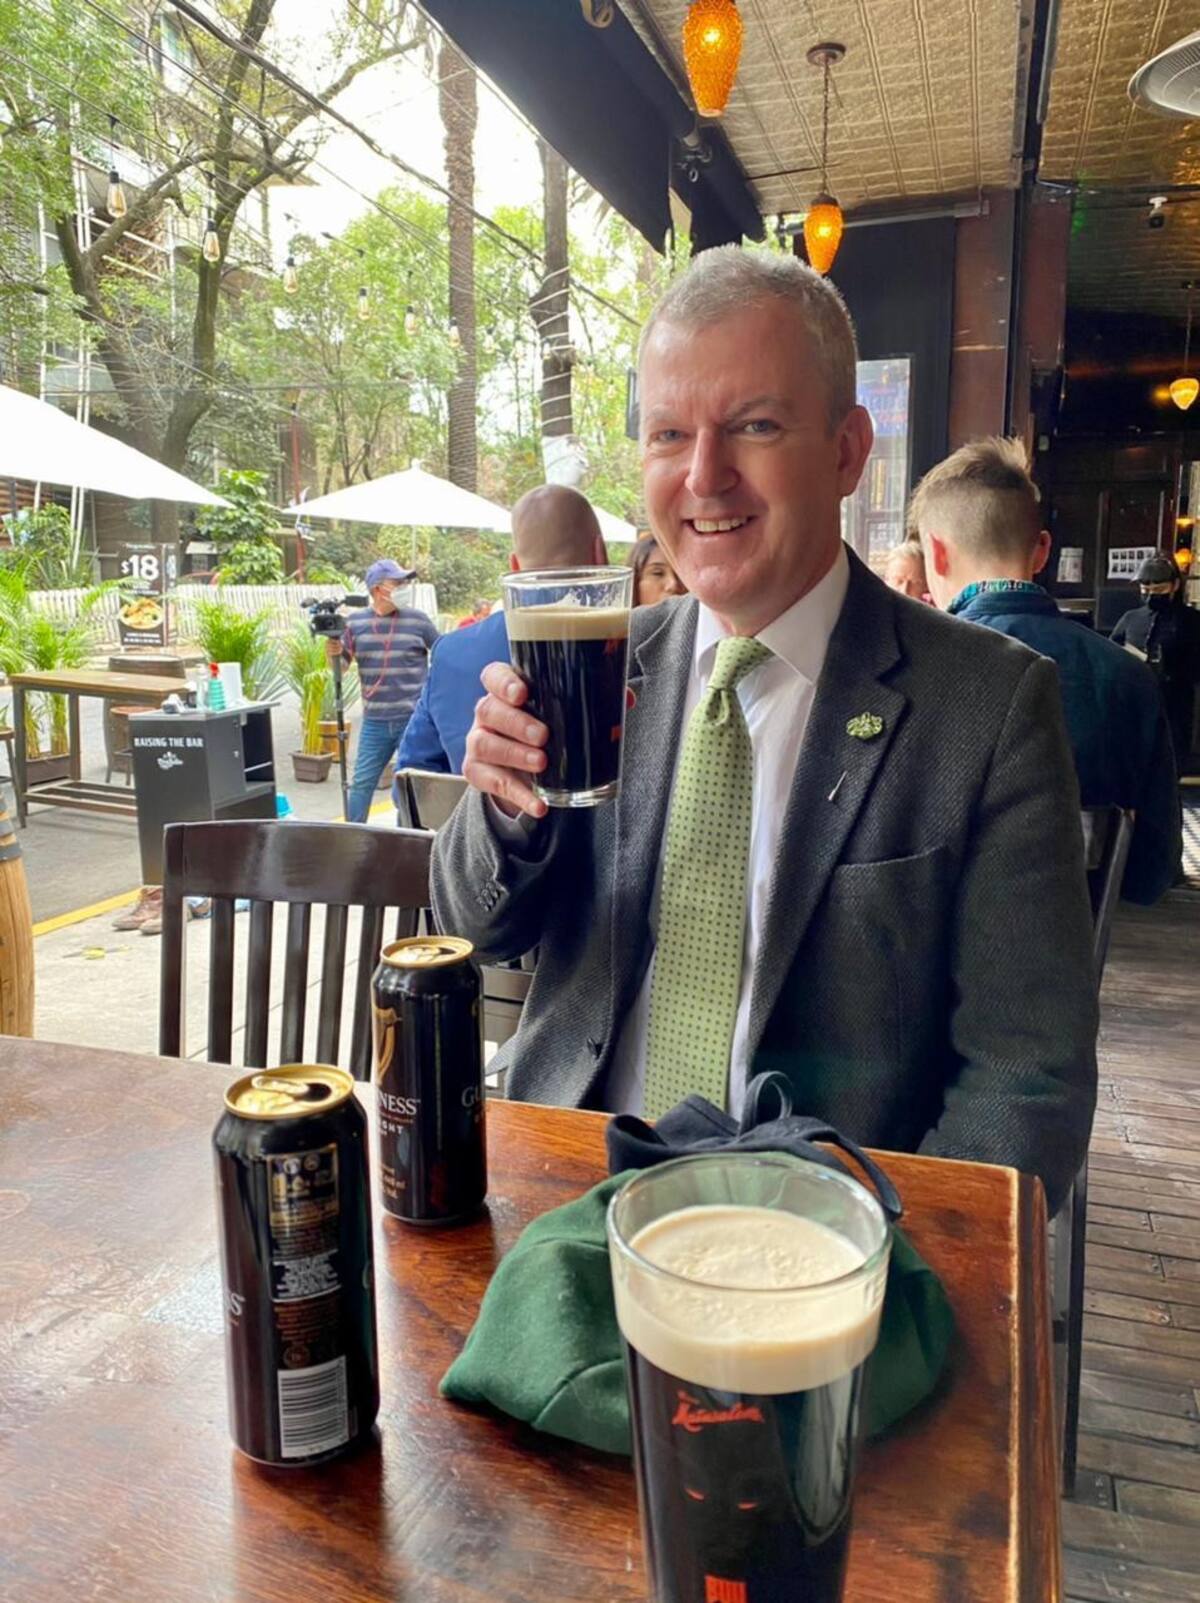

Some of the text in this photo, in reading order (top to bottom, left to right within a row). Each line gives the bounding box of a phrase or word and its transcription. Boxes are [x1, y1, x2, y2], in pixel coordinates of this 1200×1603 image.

[120, 554, 160, 581] $18
[134, 737, 204, 748] RAISING THE BAR
